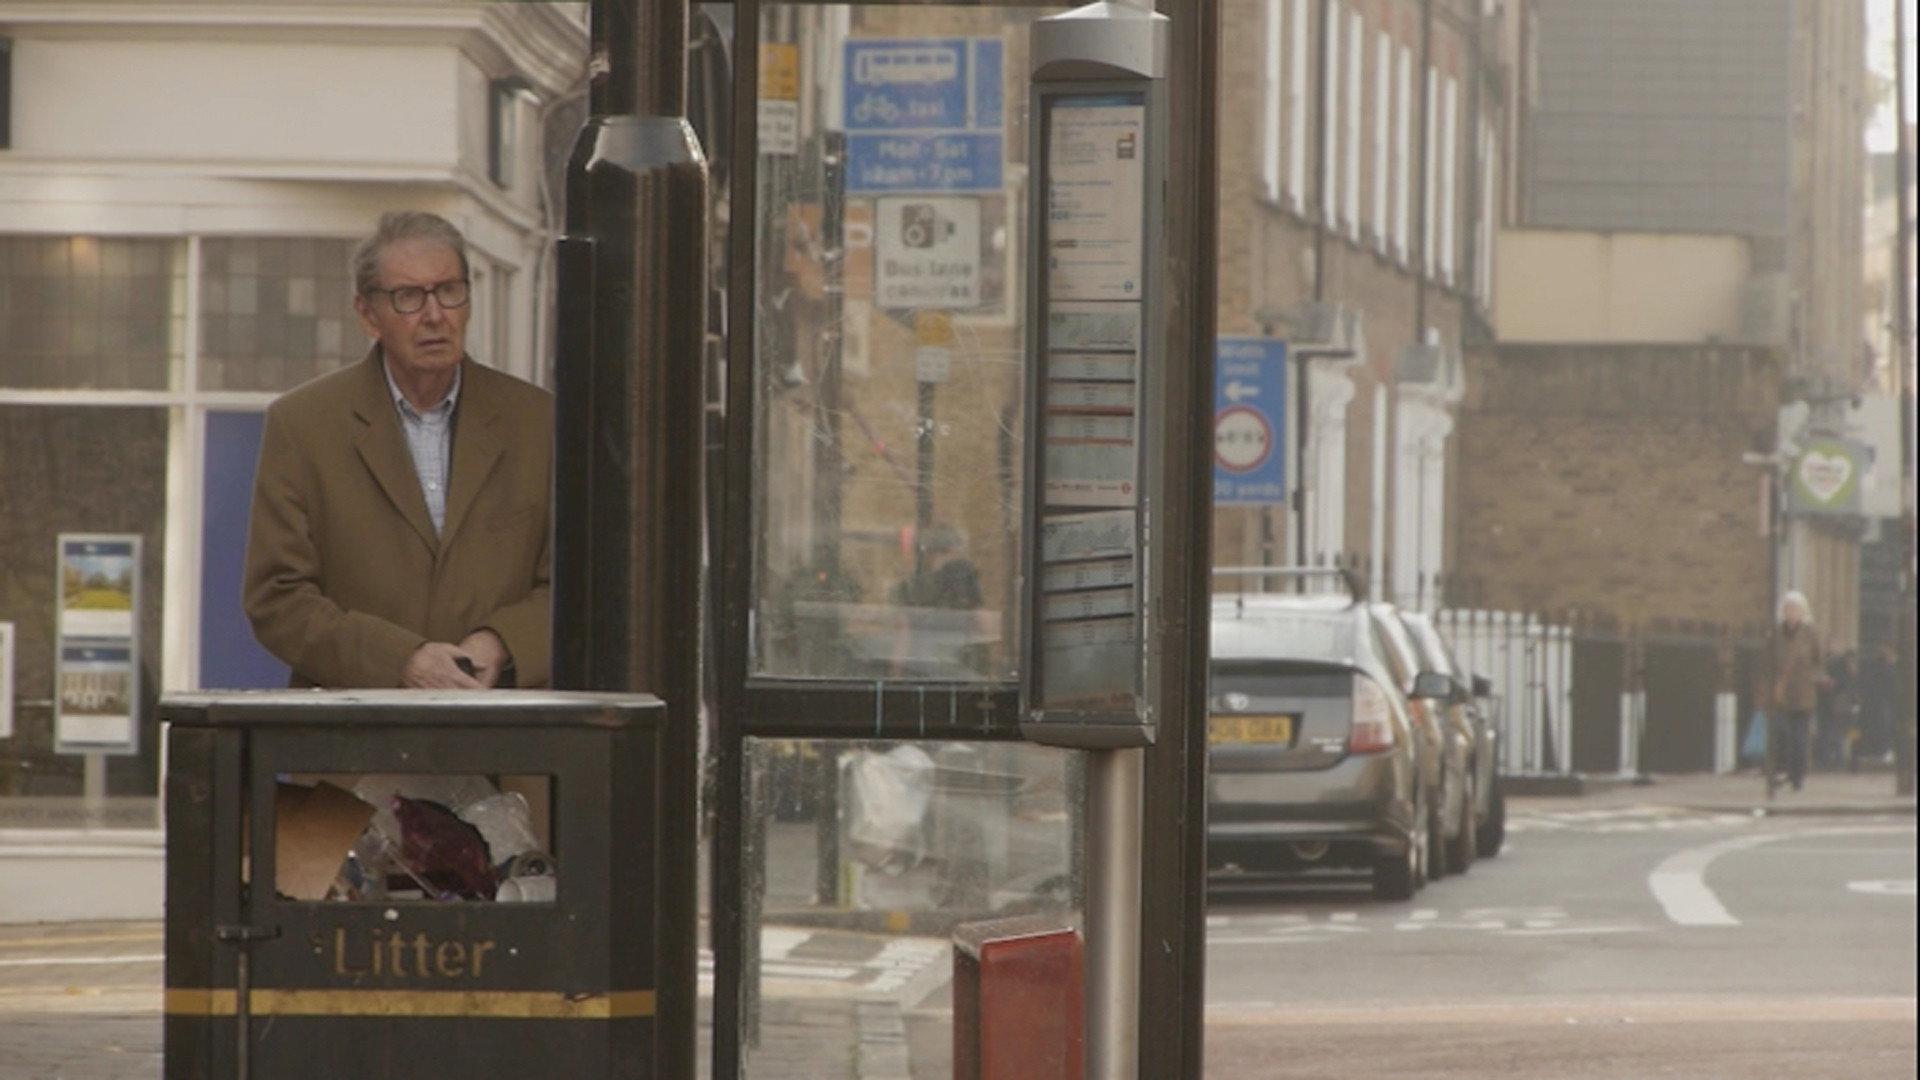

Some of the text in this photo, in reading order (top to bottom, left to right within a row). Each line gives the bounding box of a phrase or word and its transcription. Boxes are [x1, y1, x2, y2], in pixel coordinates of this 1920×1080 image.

[885, 259, 972, 277] Bus lane
[334, 927, 497, 979] Litter
